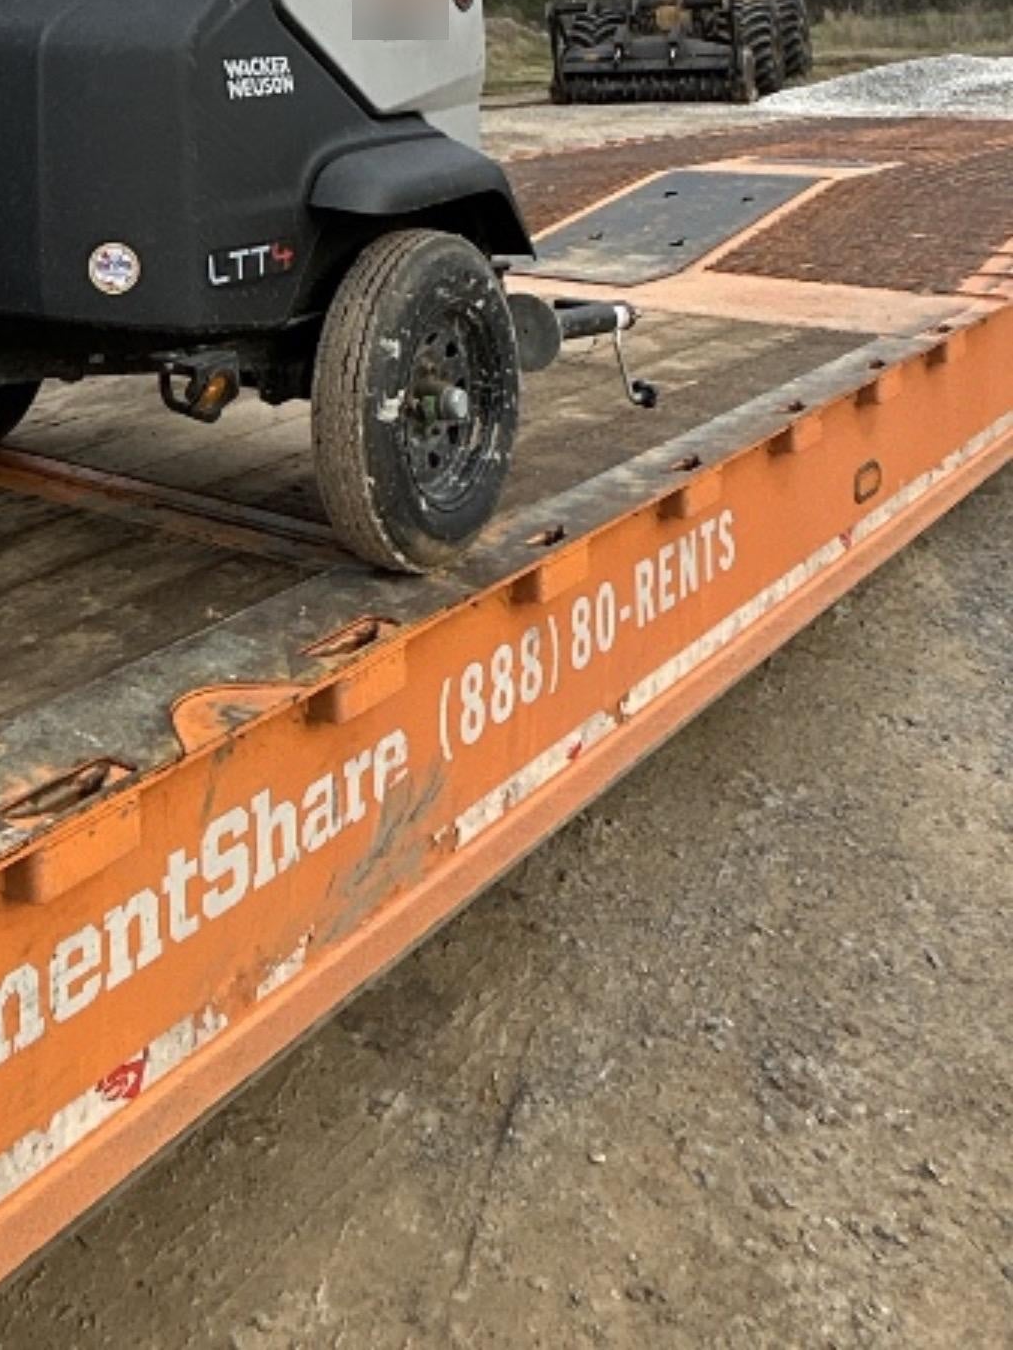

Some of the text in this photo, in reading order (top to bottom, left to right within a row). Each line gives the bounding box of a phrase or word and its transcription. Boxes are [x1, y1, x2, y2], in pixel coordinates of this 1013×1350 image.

[223, 56, 291, 79] WACKER
[227, 74, 295, 100] NEUSON
[438, 615, 559, 762] (888)
[570, 509, 736, 670] 80-RENTS
